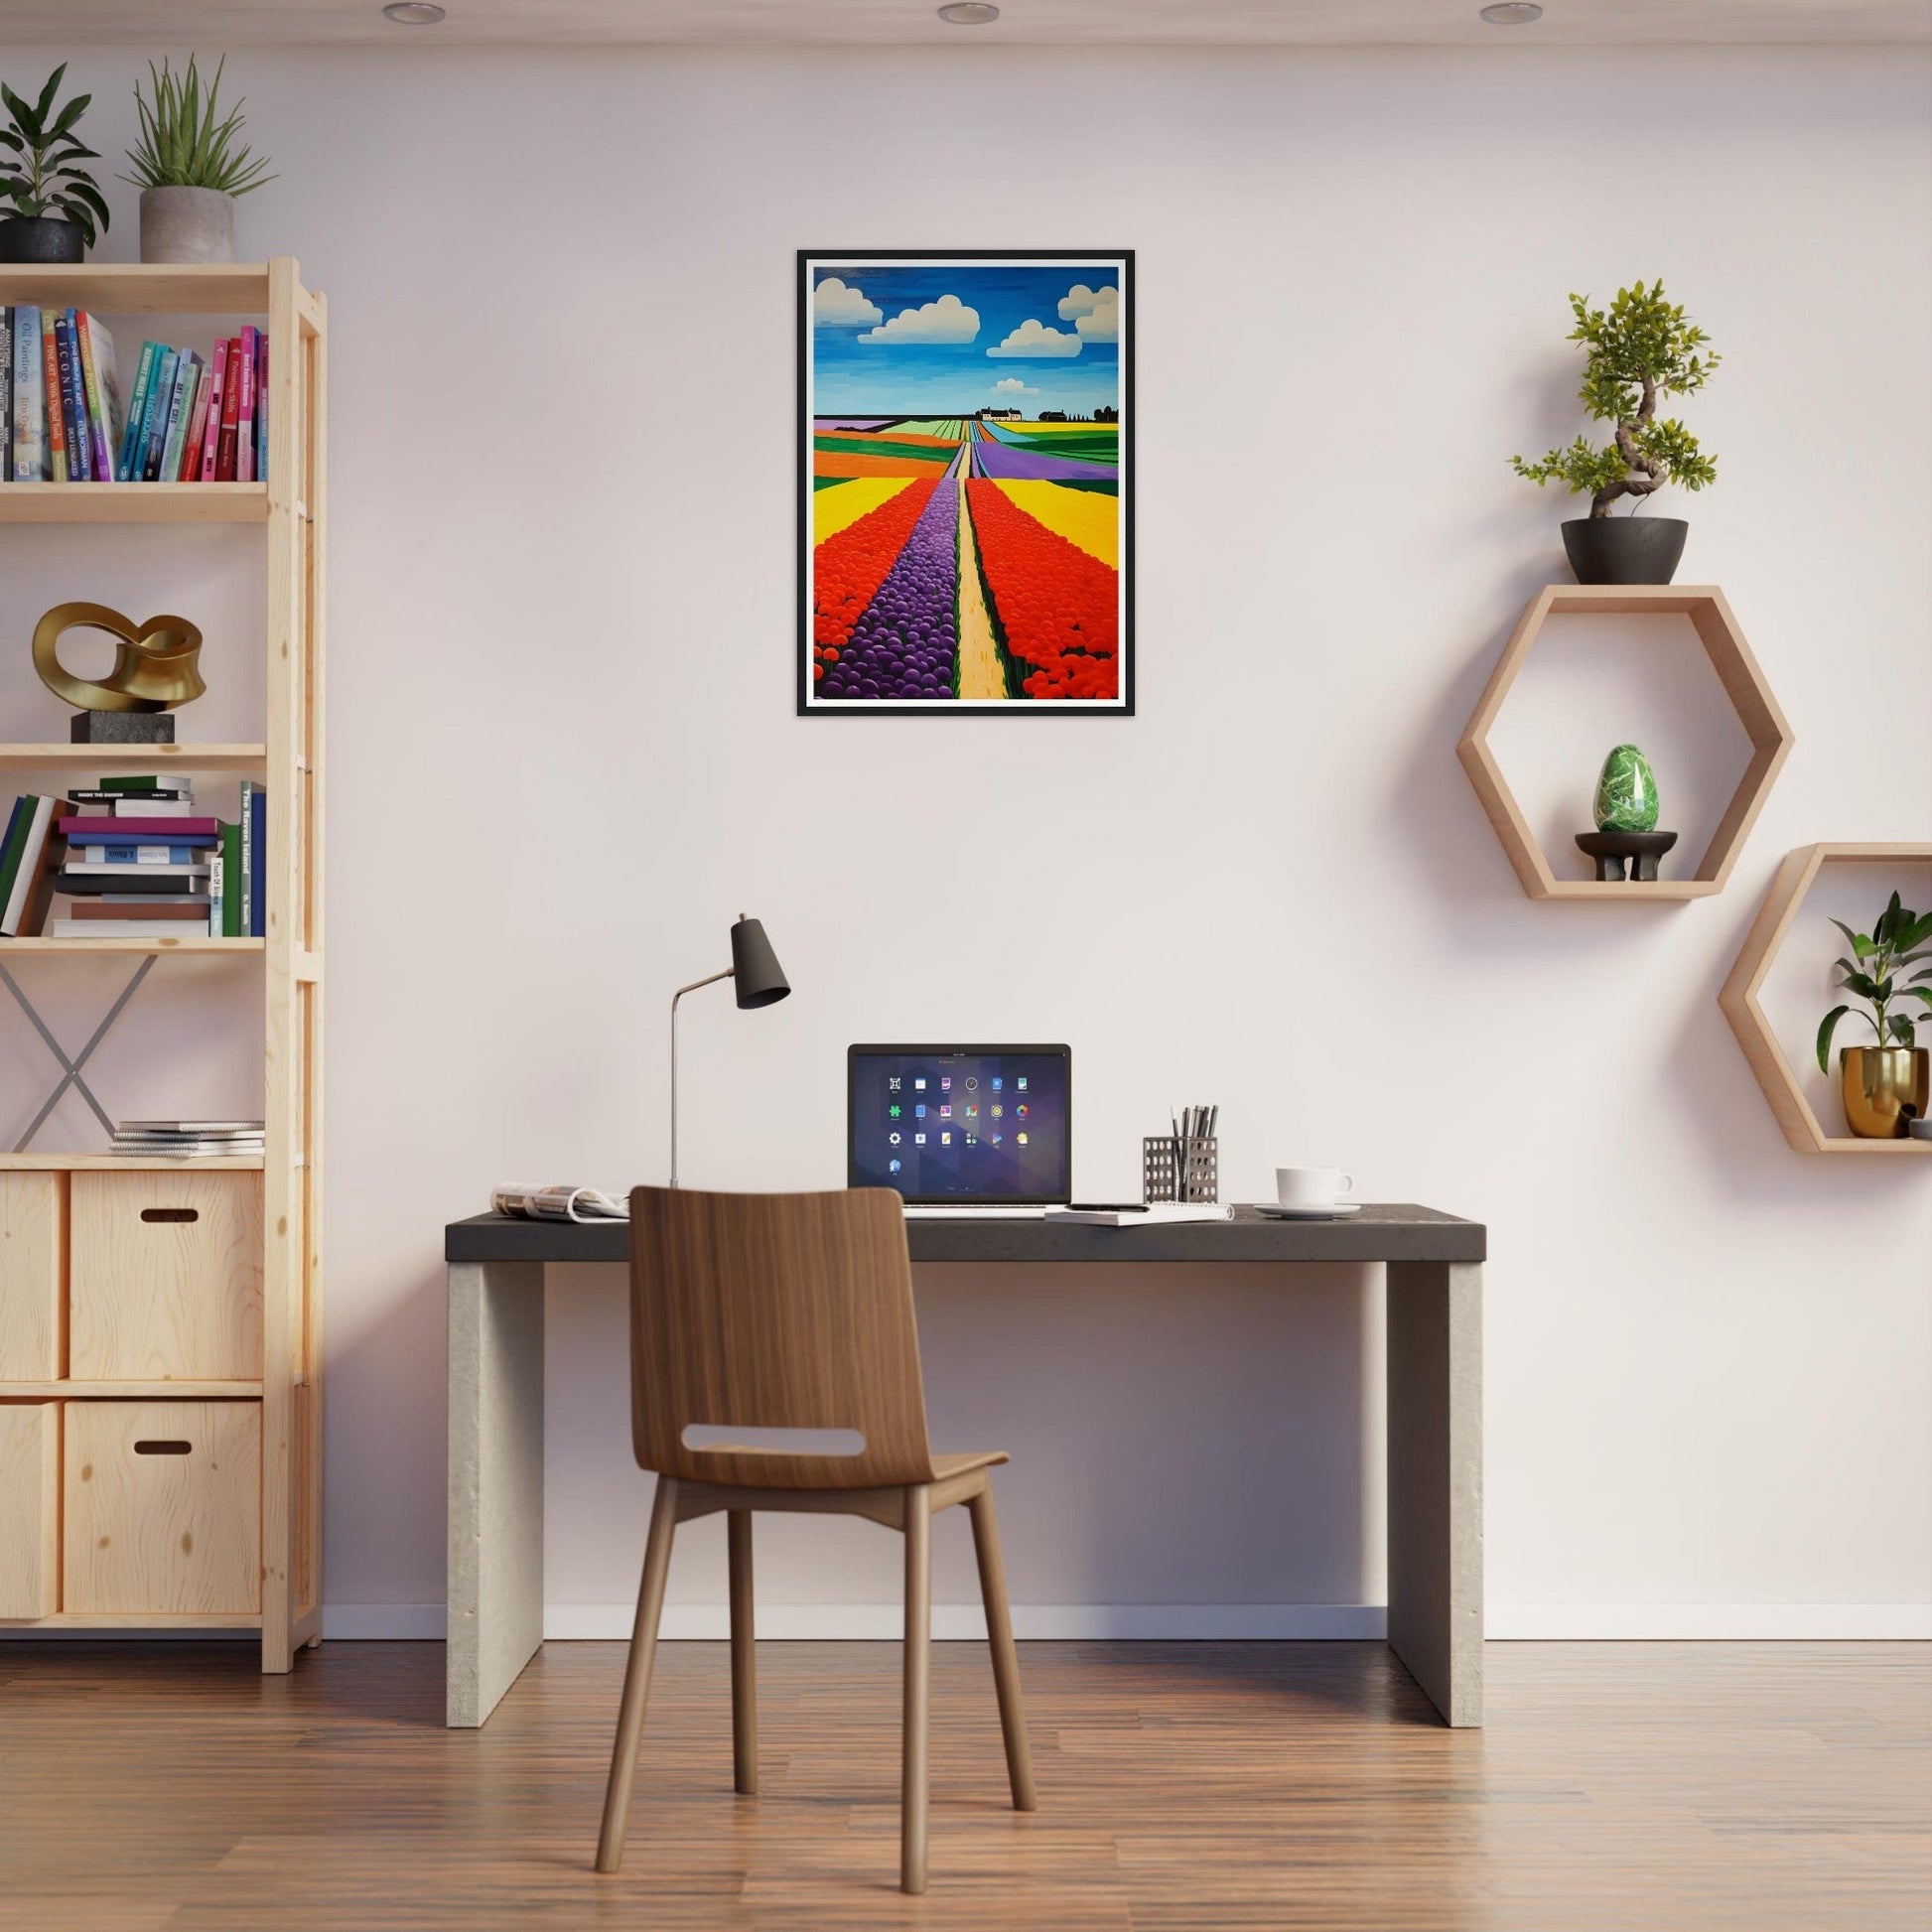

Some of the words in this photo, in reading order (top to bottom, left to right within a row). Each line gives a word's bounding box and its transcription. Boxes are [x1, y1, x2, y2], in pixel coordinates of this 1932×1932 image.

[22, 323, 32, 338] Oil
[17, 340, 32, 383] Paintings
[78, 325, 91, 370] Watercolor
[86, 372, 97, 407] Portraits
[228, 360, 238, 393] Parenting
[50, 400, 60, 421] Digital
[140, 393, 156, 443] SUCCESSFUL
[242, 788, 251, 808] The
[242, 811, 251, 841] Raven
[242, 844, 251, 875] Island
